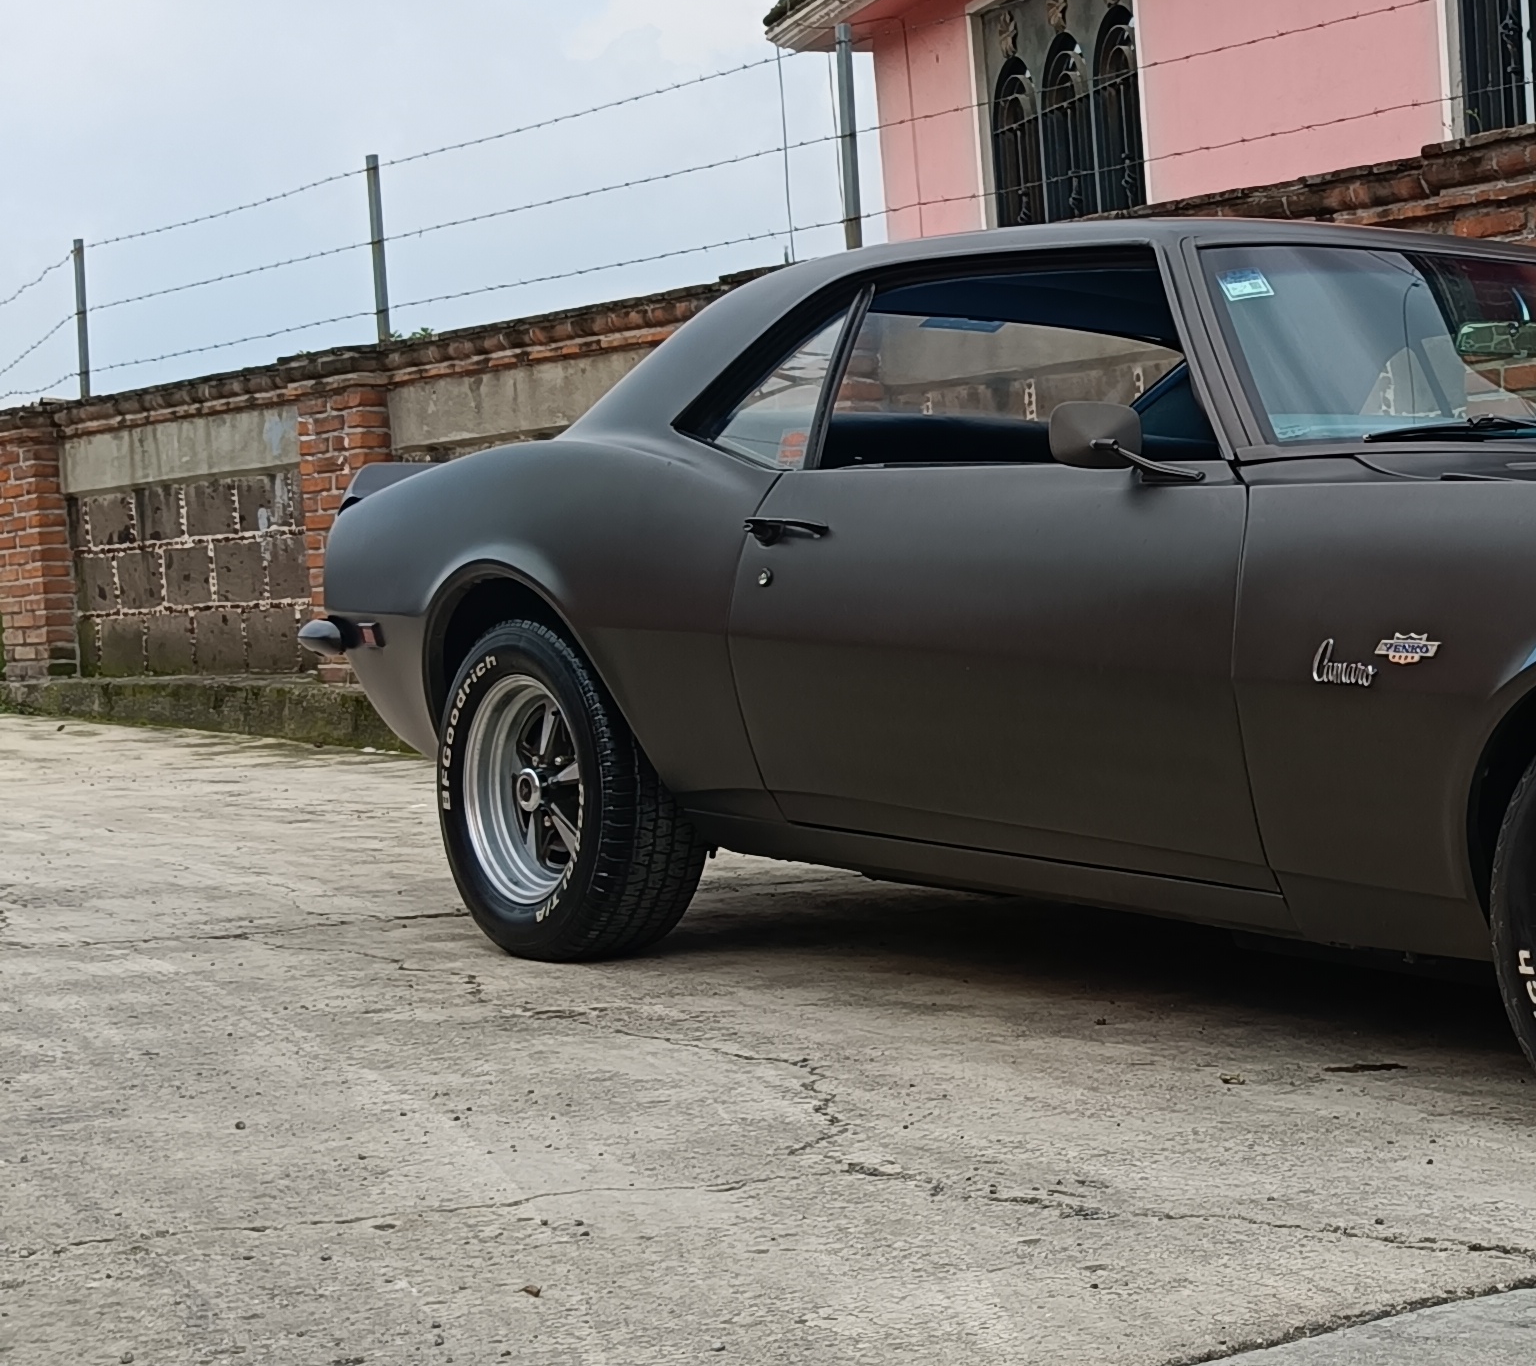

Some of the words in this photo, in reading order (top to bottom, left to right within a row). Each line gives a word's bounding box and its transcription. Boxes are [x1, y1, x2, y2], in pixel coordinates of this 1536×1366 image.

[1313, 638, 1377, 687] Camaro
[1385, 642, 1430, 655] YENKO
[441, 655, 497, 810] BFGoodrich
